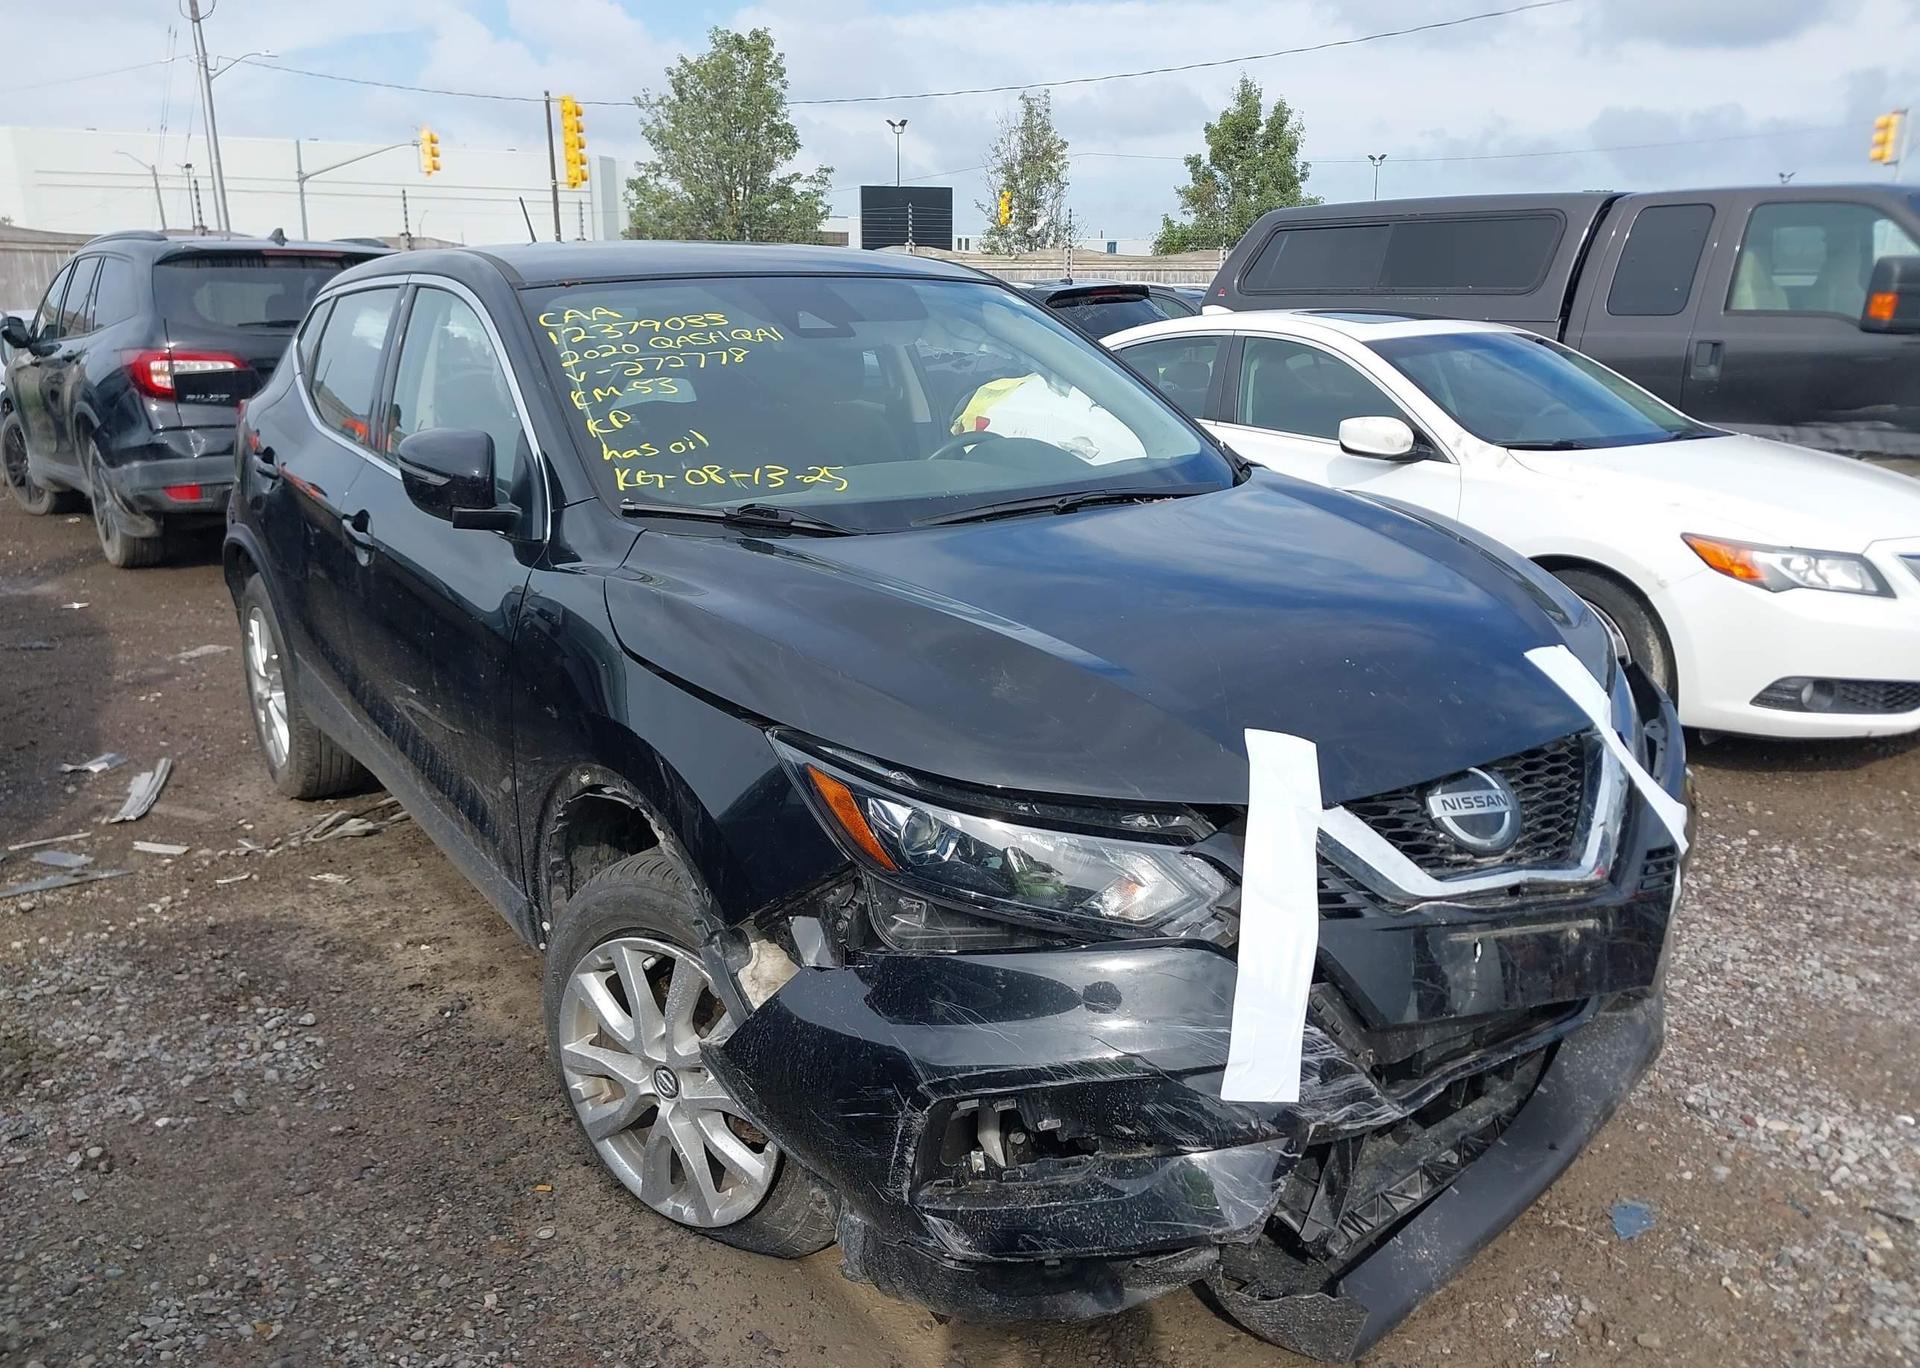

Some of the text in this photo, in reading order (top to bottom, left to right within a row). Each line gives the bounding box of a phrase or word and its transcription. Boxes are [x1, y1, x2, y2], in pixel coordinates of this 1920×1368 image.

[539, 306, 623, 327] CAA
[548, 313, 729, 345] 12379033
[560, 326, 784, 367] 2020 QASHQAI
[602, 429, 710, 460] has oil
[1441, 794, 1508, 811] NISSAN
